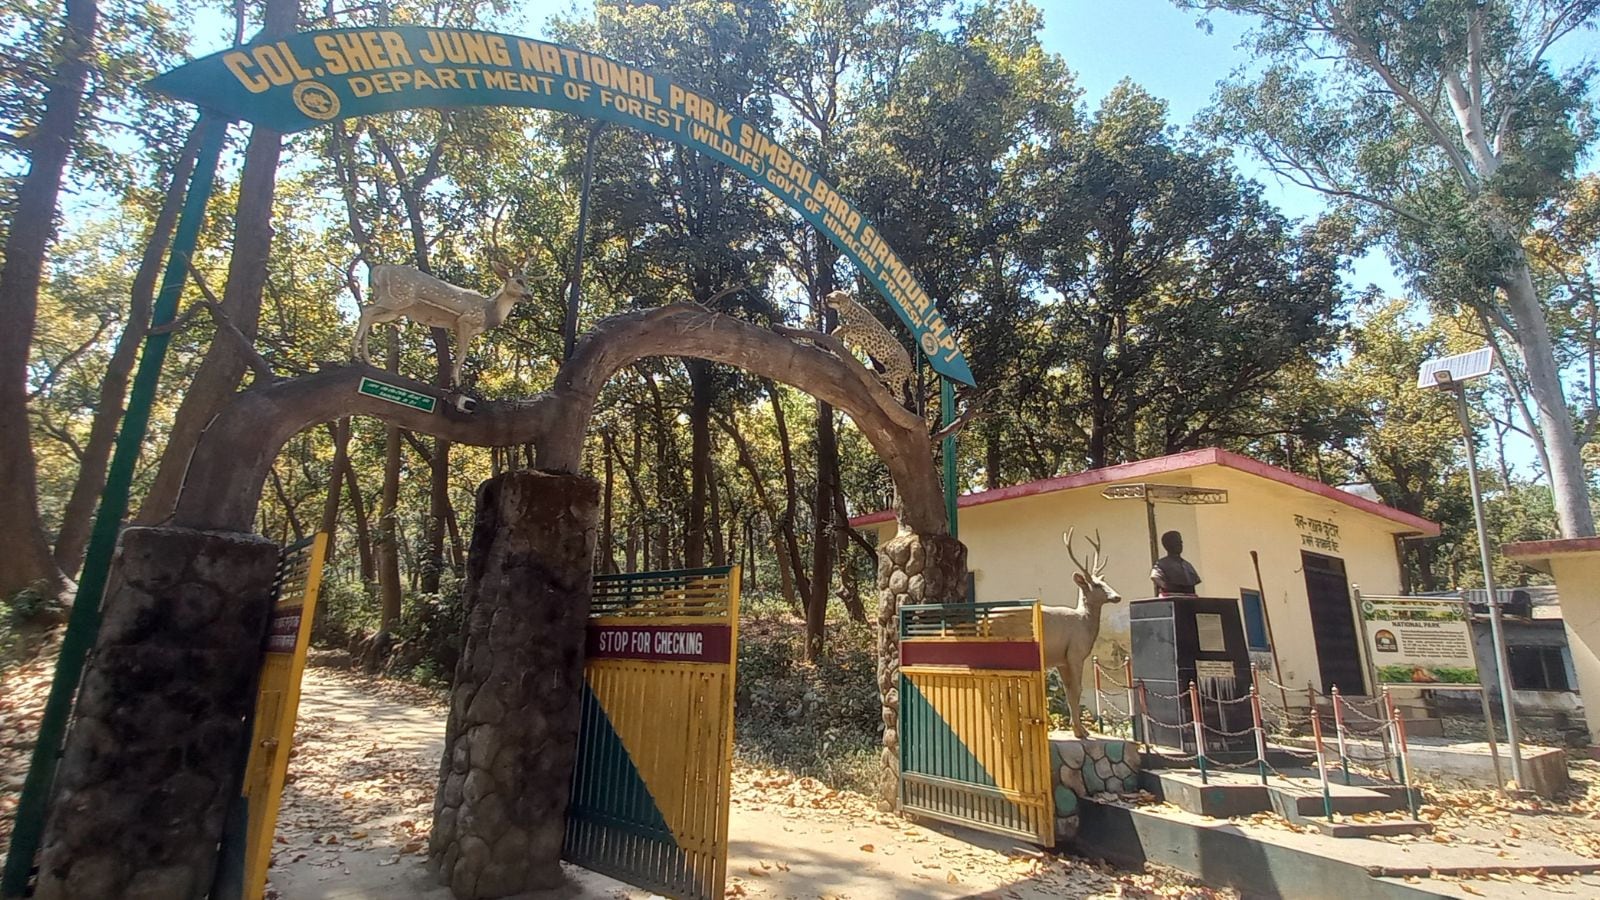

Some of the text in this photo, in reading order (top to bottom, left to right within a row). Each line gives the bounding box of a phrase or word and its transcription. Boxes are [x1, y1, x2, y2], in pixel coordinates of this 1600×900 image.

[347, 66, 555, 98] DEPARTMENT
[563, 81, 592, 103] OF
[600, 89, 685, 133] FOREST
[687, 121, 766, 176] (WILDLIFE)
[804, 197, 822, 215] OF
[823, 213, 878, 274] HIMACHAL
[878, 271, 923, 329] PRADESH
[419, 32, 511, 66] JUNG
[516, 40, 662, 105] NATIONAL
[669, 86, 733, 136] PARK
[739, 123, 862, 233] SIMBALBARA
[860, 227, 930, 315] SIRMOUR
[599, 631, 704, 656] STOP FOR CHECKING
